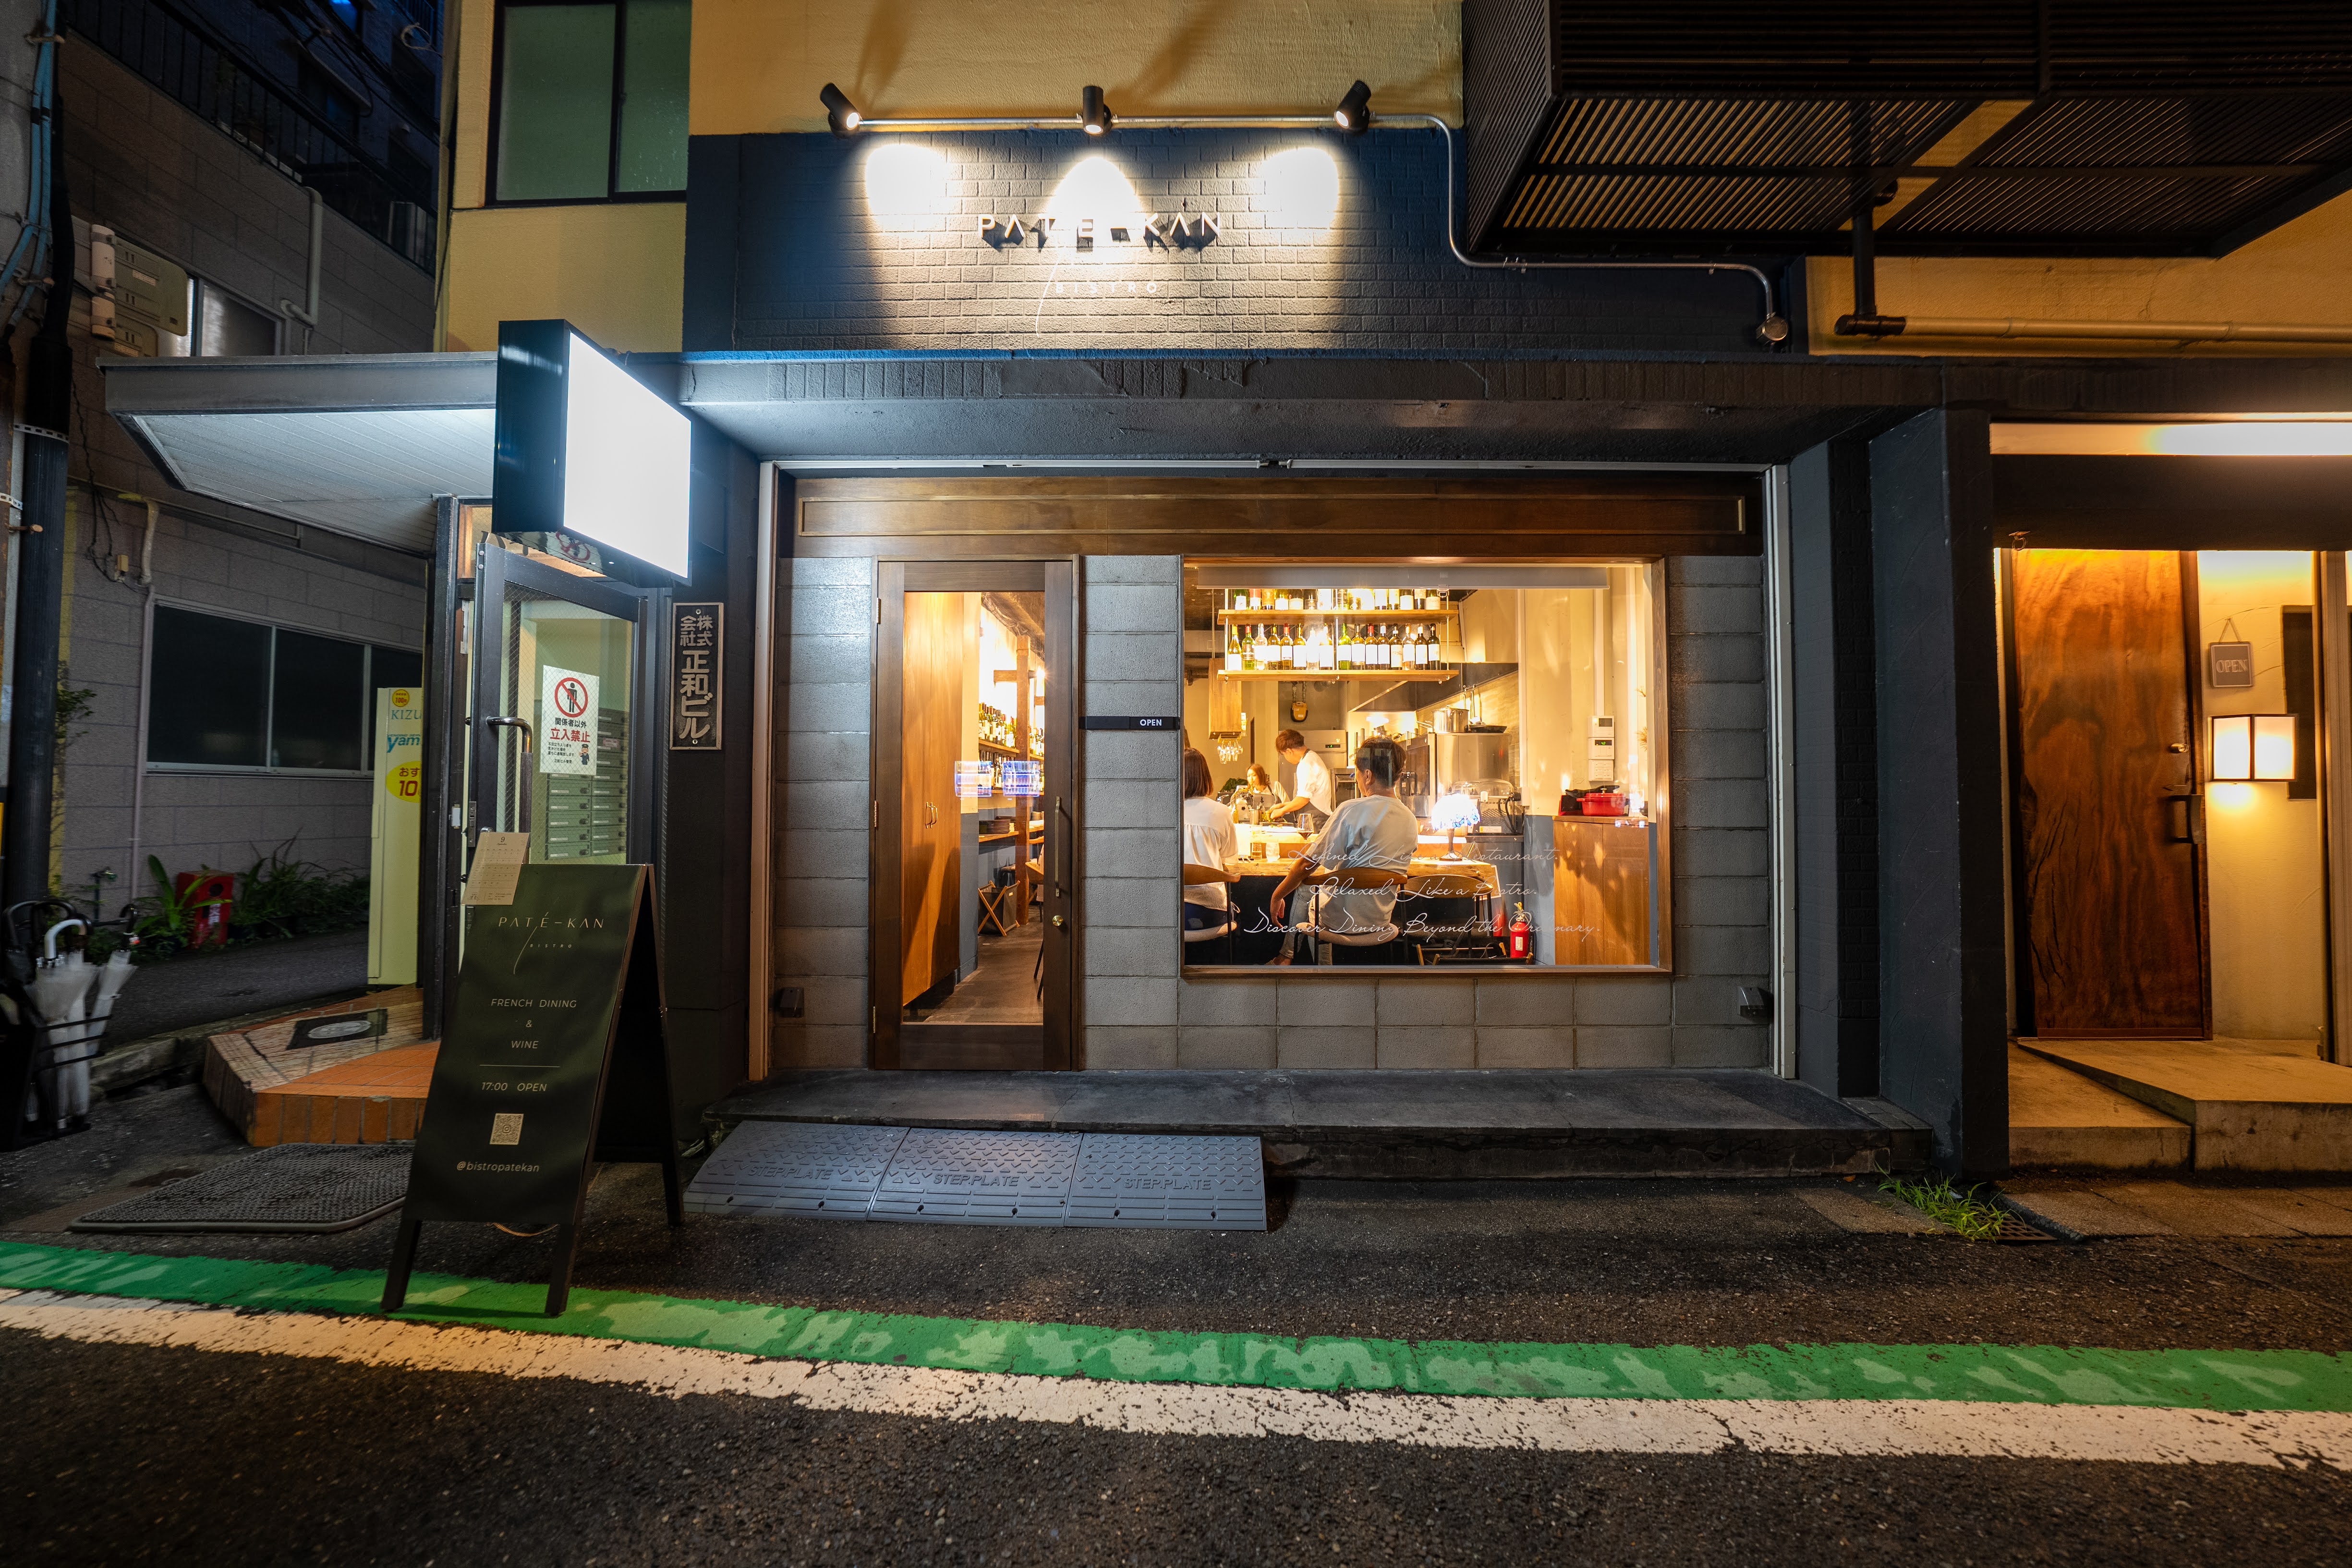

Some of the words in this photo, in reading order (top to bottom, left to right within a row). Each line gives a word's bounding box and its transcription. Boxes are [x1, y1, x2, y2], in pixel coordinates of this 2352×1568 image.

[1056, 281, 1157, 294] BISTRO
[2216, 659, 2248, 673] OPEN
[679, 650, 714, 739] 正和ビル
[555, 717, 587, 729] 関係者以外
[550, 728, 590, 742] 立入禁止
[399, 780, 421, 796] 10
[1285, 842, 1368, 870] Refined
[1369, 844, 1427, 867] Like
[1306, 876, 1394, 904] Relaxed
[1394, 877, 1454, 902] Like
[1243, 907, 1326, 933] Discover
[1328, 907, 1400, 942] Dining
[1402, 912, 1478, 943] Beyond
[1474, 913, 1503, 933] the
[1508, 912, 1601, 943] Ordnary.
[491, 998, 533, 1007] FRENCH
[539, 999, 577, 1008] DINING
[525, 1020, 533, 1028] &
[511, 1040, 539, 1049] WINE
[482, 1082, 508, 1091] 17:00
[517, 1083, 547, 1092] OPEN
[456, 1160, 540, 1173] @bistropatekan
